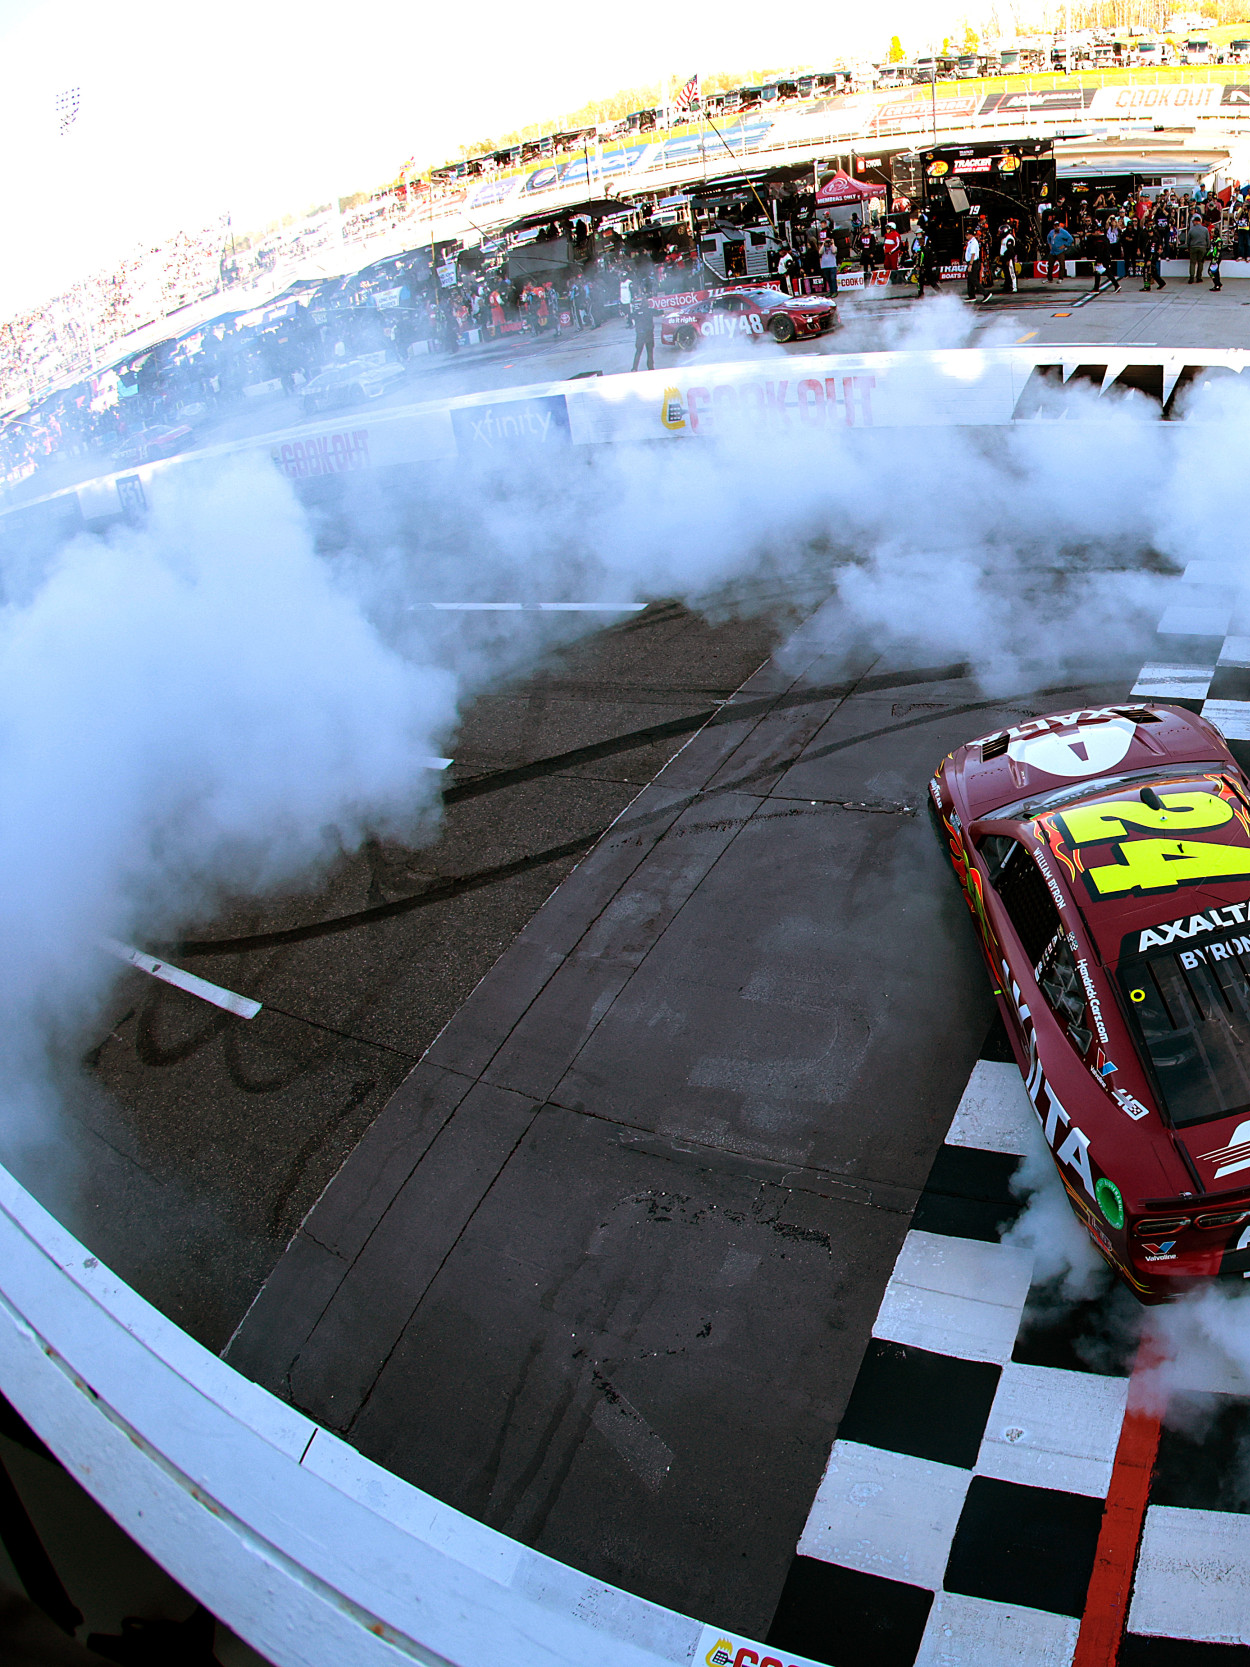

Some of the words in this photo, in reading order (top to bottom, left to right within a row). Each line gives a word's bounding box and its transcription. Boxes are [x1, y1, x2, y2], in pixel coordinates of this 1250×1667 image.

[954, 158, 992, 168] TRACKER
[970, 205, 980, 214] 19
[870, 270, 891, 286] 19
[701, 314, 737, 338] ally
[739, 313, 765, 335] 48
[686, 379, 789, 434] COOK
[799, 375, 876, 428] OUT
[470, 405, 552, 448] xfinity
[280, 434, 334, 478] COOK
[332, 429, 369, 472] OUT
[1033, 847, 1053, 881] WILLIAM
[1048, 878, 1066, 910] BYRON
[1145, 1254, 1178, 1263] Valvoline
